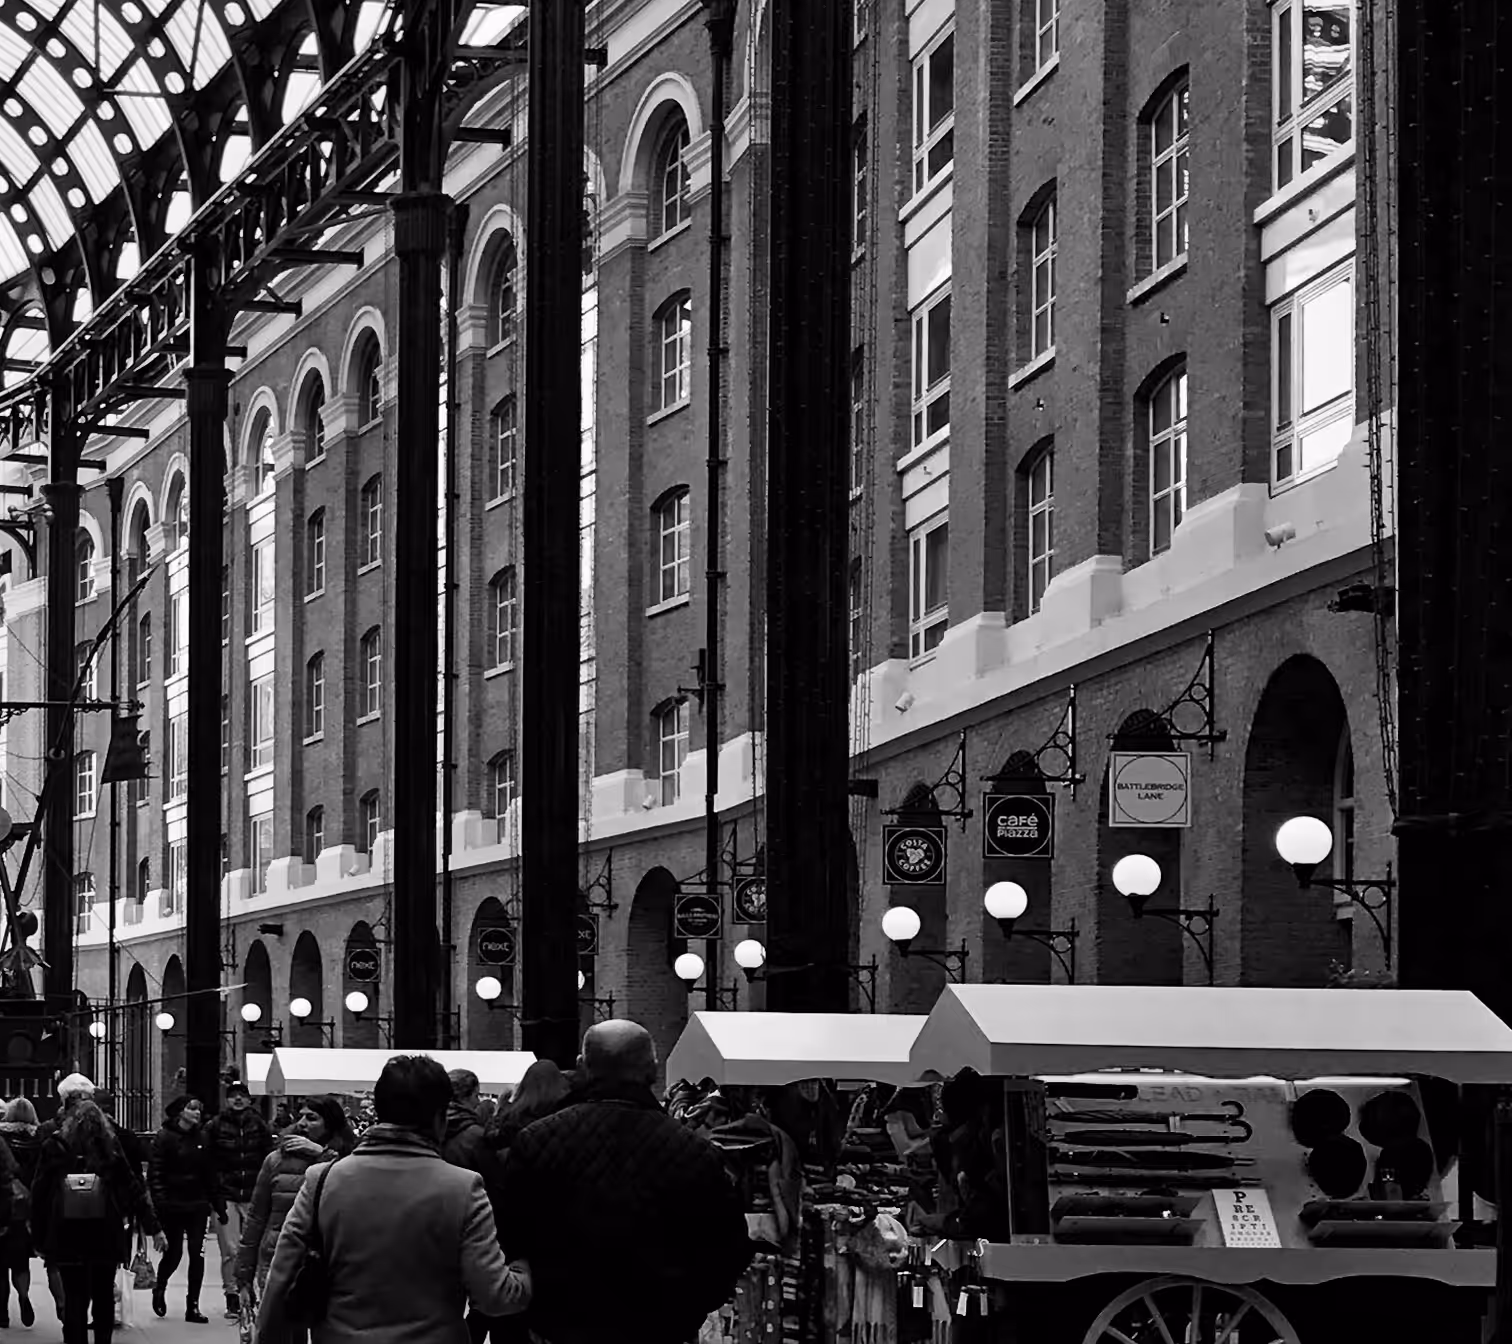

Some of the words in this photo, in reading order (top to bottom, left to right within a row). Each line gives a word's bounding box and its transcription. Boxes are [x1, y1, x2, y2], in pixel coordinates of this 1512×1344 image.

[1117, 783, 1185, 791] BATTLEBRIDGE
[1138, 793, 1164, 801] LANE
[900, 839, 928, 850] COSTA
[898, 859, 931, 872] COFFEE
[1233, 1191, 1246, 1203] P
[1233, 1204, 1255, 1213] RE
